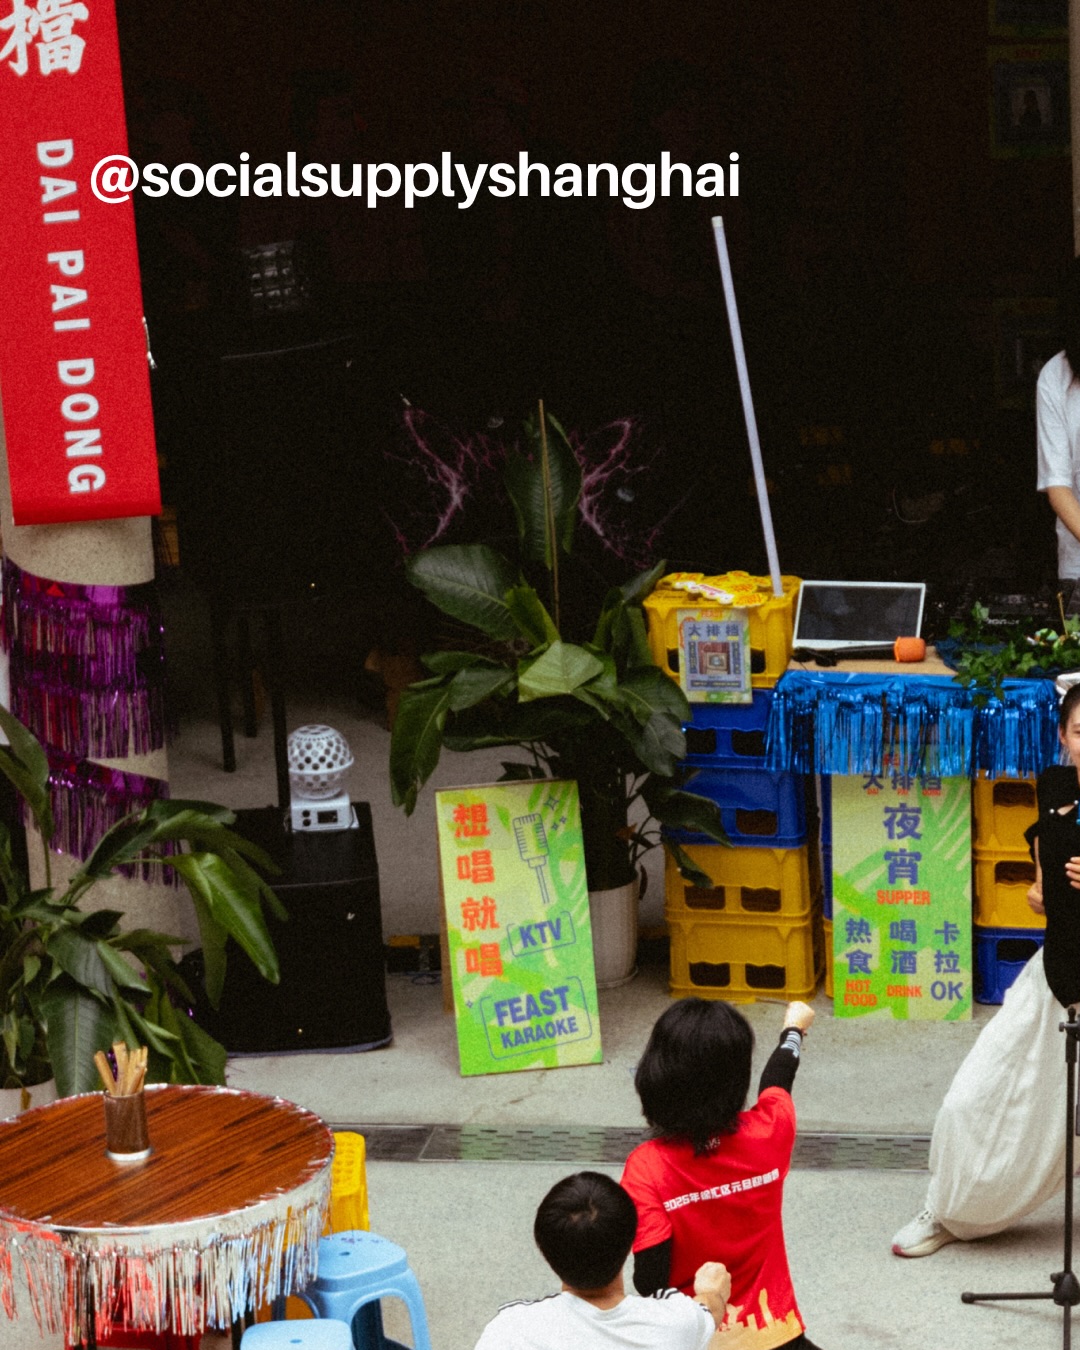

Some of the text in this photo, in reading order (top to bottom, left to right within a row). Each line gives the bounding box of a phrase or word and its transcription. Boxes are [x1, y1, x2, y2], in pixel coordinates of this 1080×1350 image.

[0, 0, 89, 76] 檔
[37, 139, 106, 493] DAI PAI DONG
[883, 803, 922, 885] 夜宵
[453, 803, 503, 977] 想唱就唱
[877, 890, 931, 905] SUPPER
[519, 917, 562, 948] KTV
[845, 918, 872, 974] 热食
[890, 919, 917, 975] 喝酒
[494, 985, 569, 1026] FEAST
[844, 994, 877, 1006] FOOD
[846, 980, 871, 992] HOT
[887, 985, 922, 997] DRINK
[501, 1016, 579, 1049] KARAOKE
